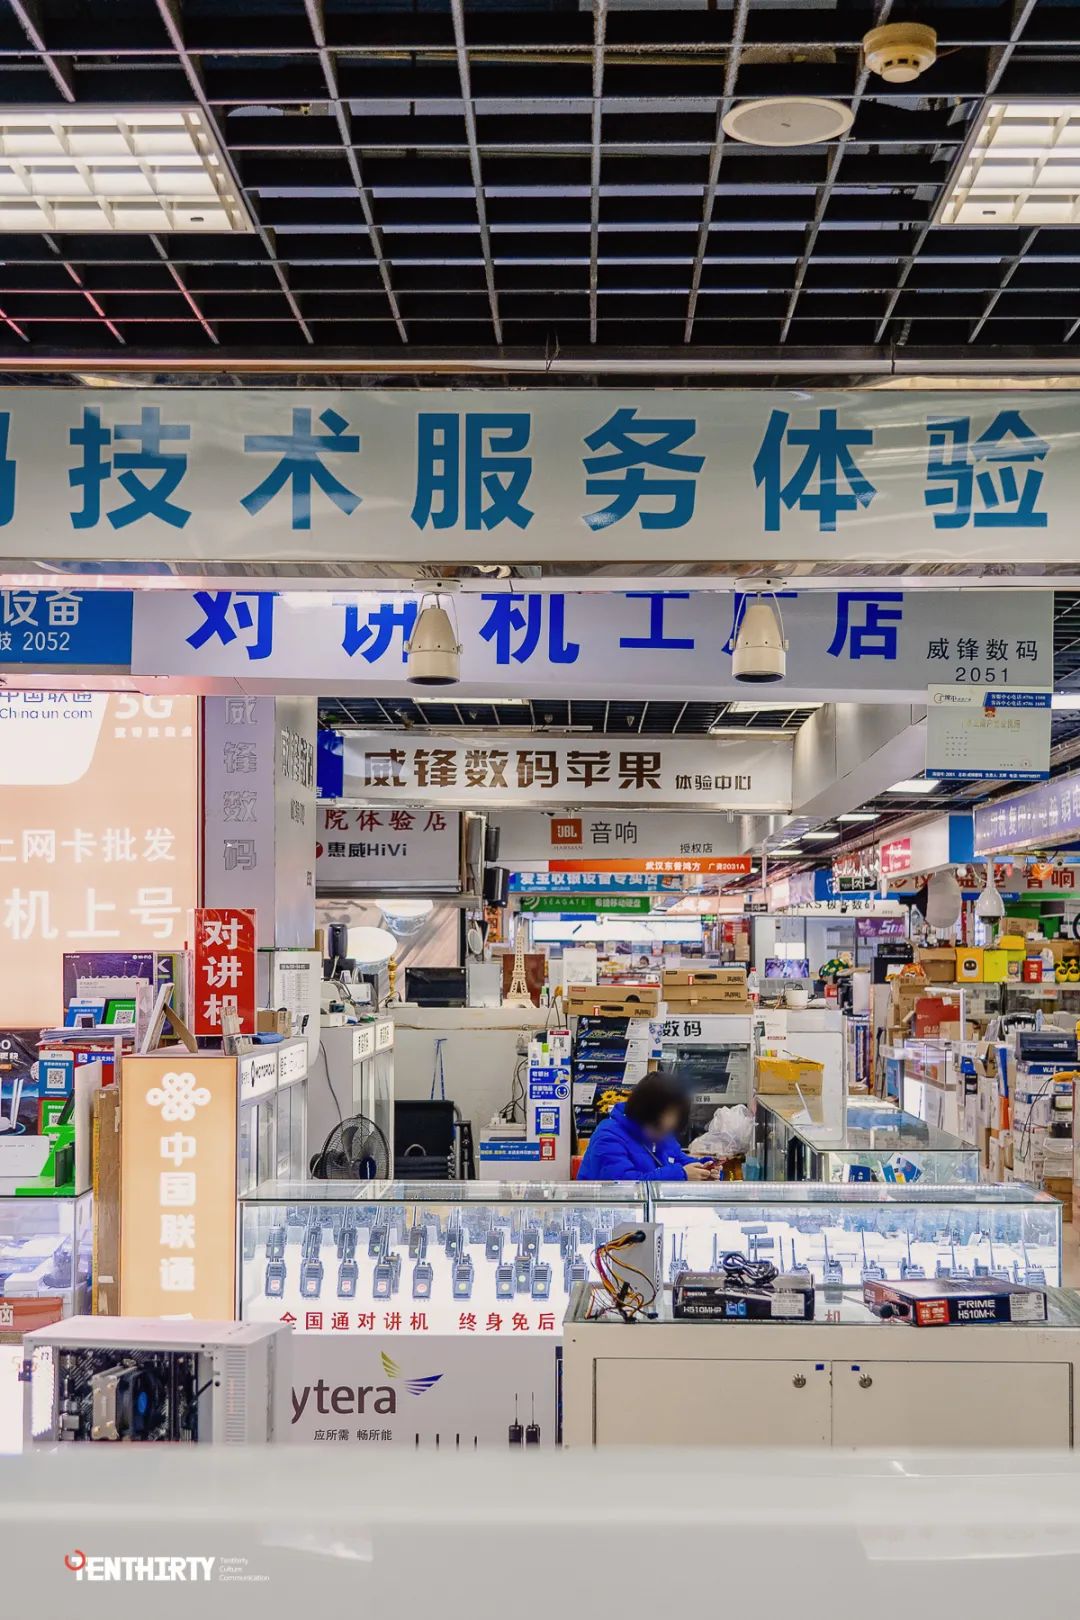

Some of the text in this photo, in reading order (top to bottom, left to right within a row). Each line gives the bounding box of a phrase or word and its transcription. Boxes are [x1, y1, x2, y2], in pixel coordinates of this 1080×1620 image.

[22, 632, 70, 651] 2052
[926, 637, 1038, 661] 威锋数码
[955, 666, 1009, 682] 2051
[364, 748, 752, 791] 威锋数码苹果 体验中心
[556, 824, 578, 839] JBL
[589, 820, 638, 845] 音响
[680, 842, 713, 854] 授权店
[3, 886, 182, 941] 机上号
[202, 918, 244, 1027] 对讲机
[662, 1020, 702, 1037] 数码
[957, 1299, 996, 1309] PRIME
[280, 1311, 429, 1331] 全国通对讲机
[957, 1309, 996, 1320] H510M-K
[314, 1429, 393, 1441] 应所需 畅所能
